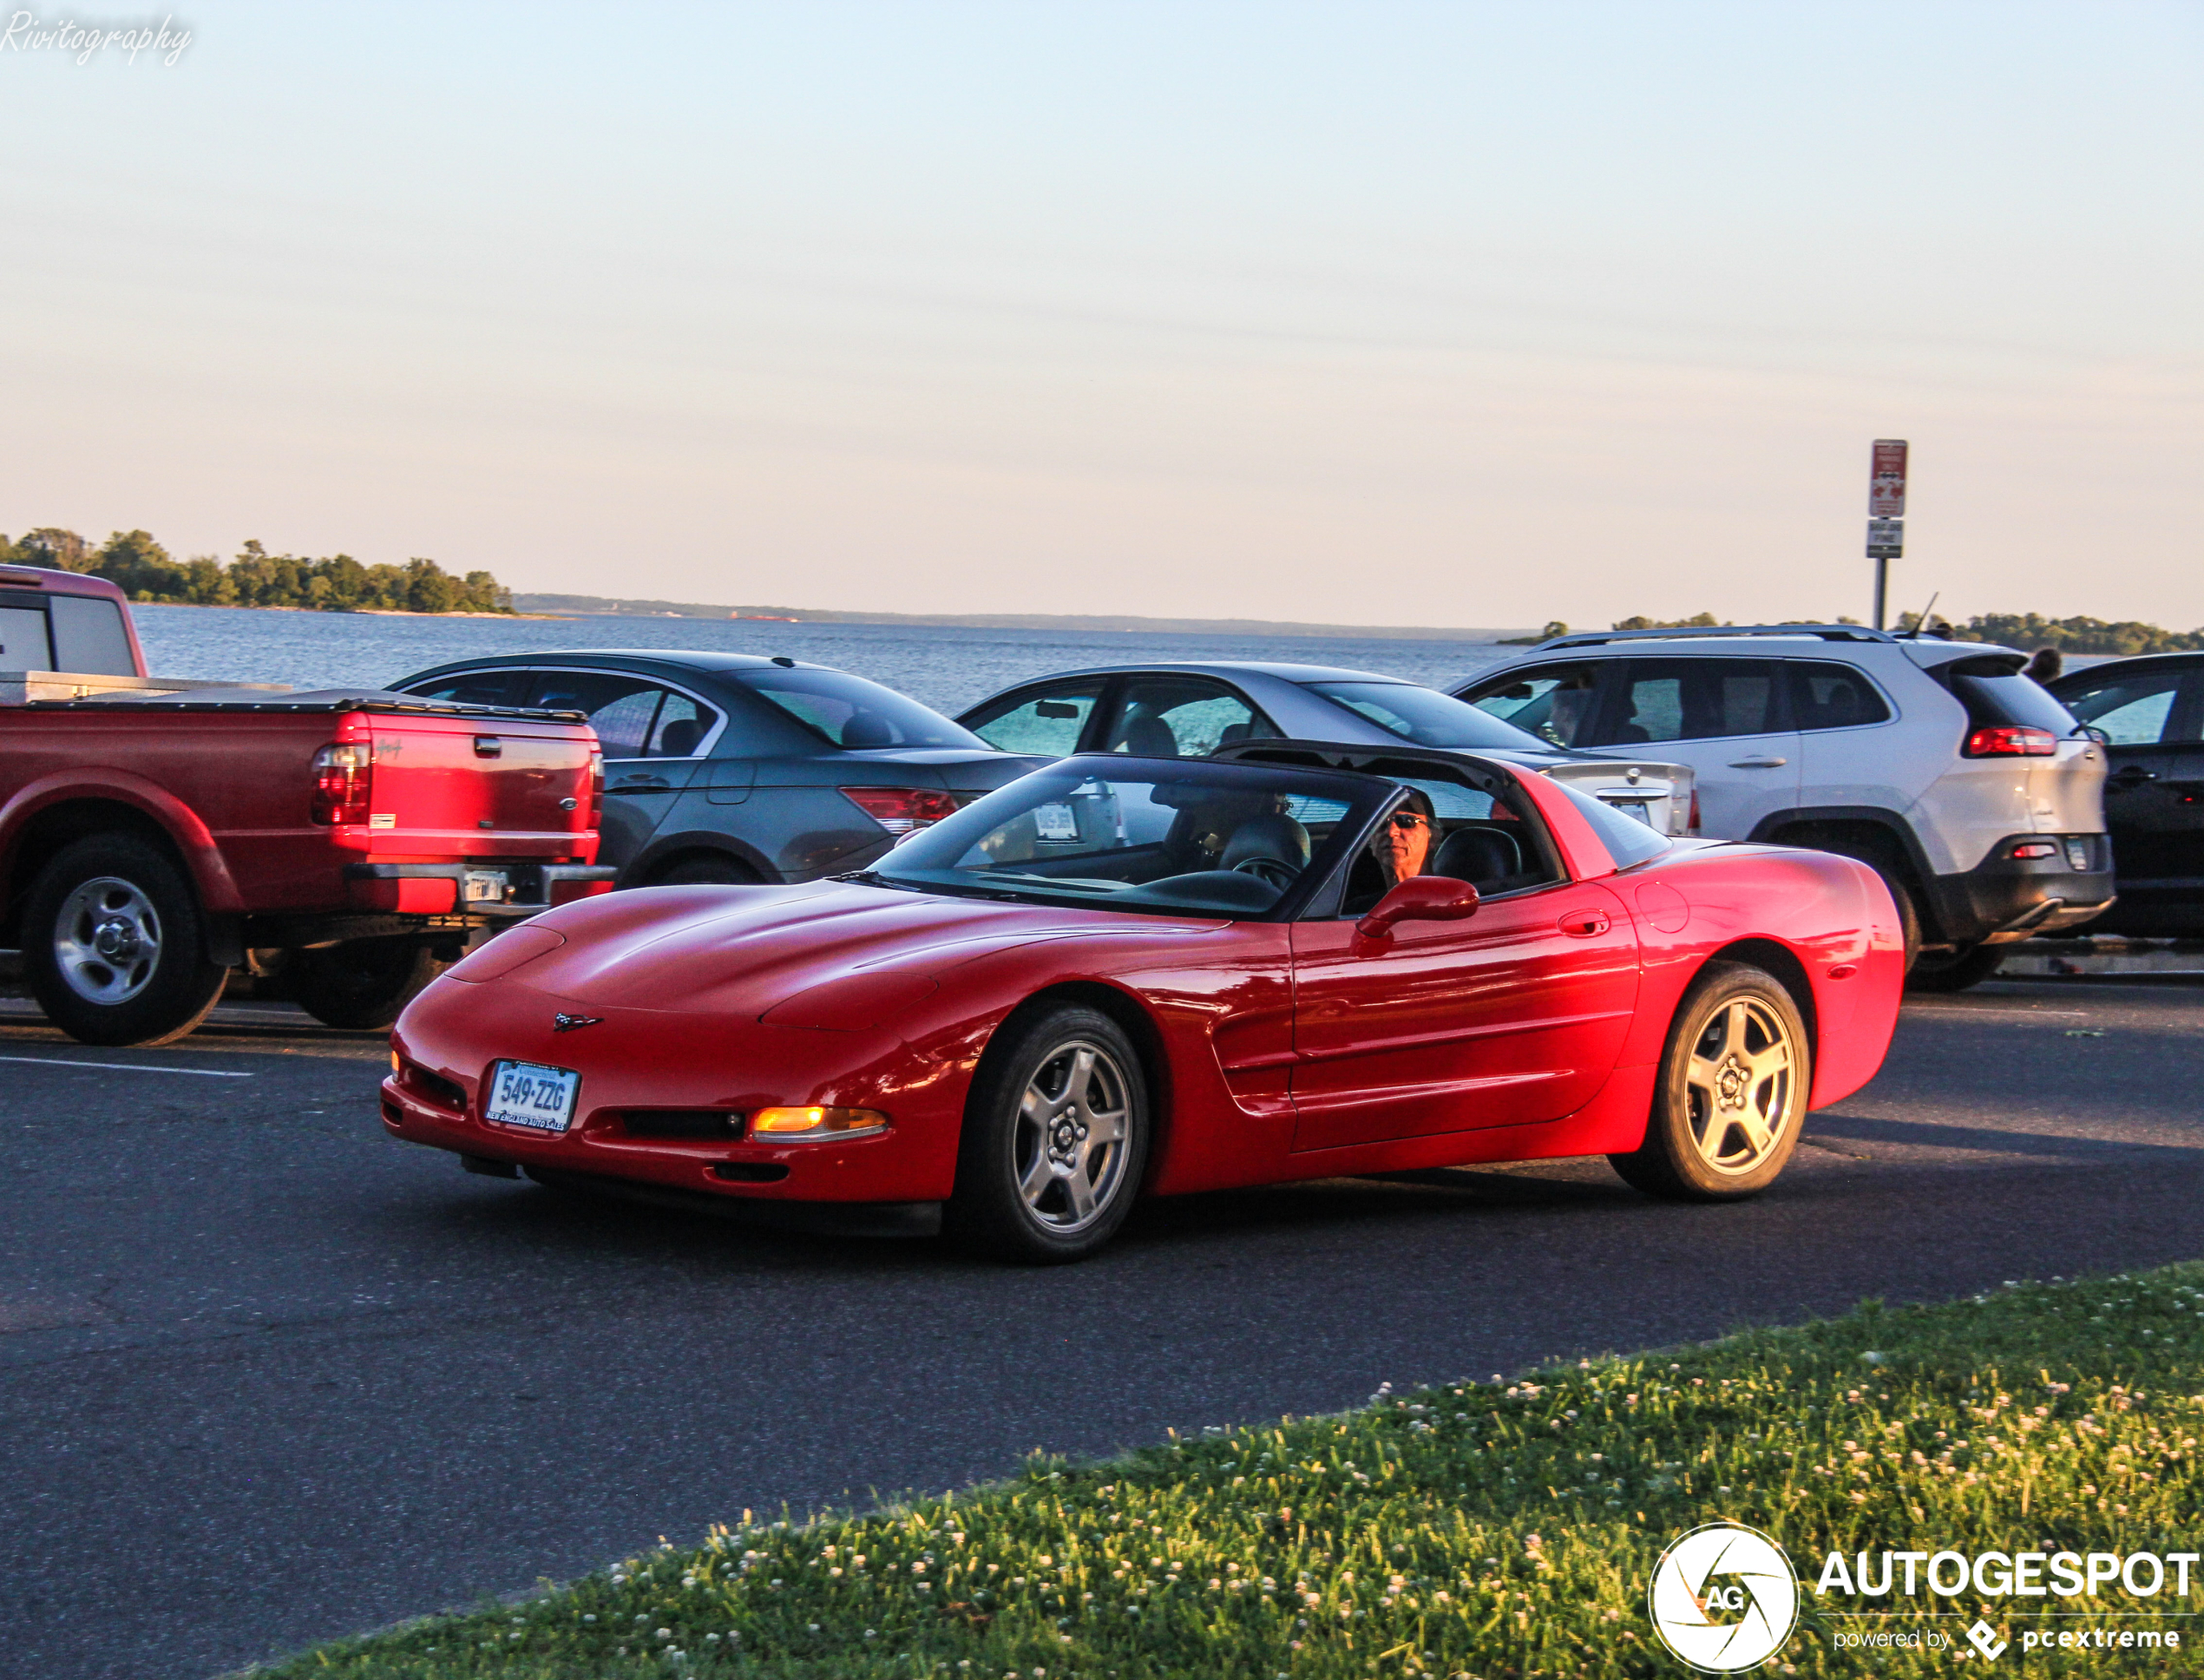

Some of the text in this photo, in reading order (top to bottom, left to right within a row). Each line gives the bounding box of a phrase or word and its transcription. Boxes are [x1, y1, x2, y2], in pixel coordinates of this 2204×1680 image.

[487, 1112, 500, 1120] NEW
[501, 1114, 528, 1125] ENGLAND
[528, 1119, 546, 1127] AUTO
[546, 1120, 565, 1131] SALES
